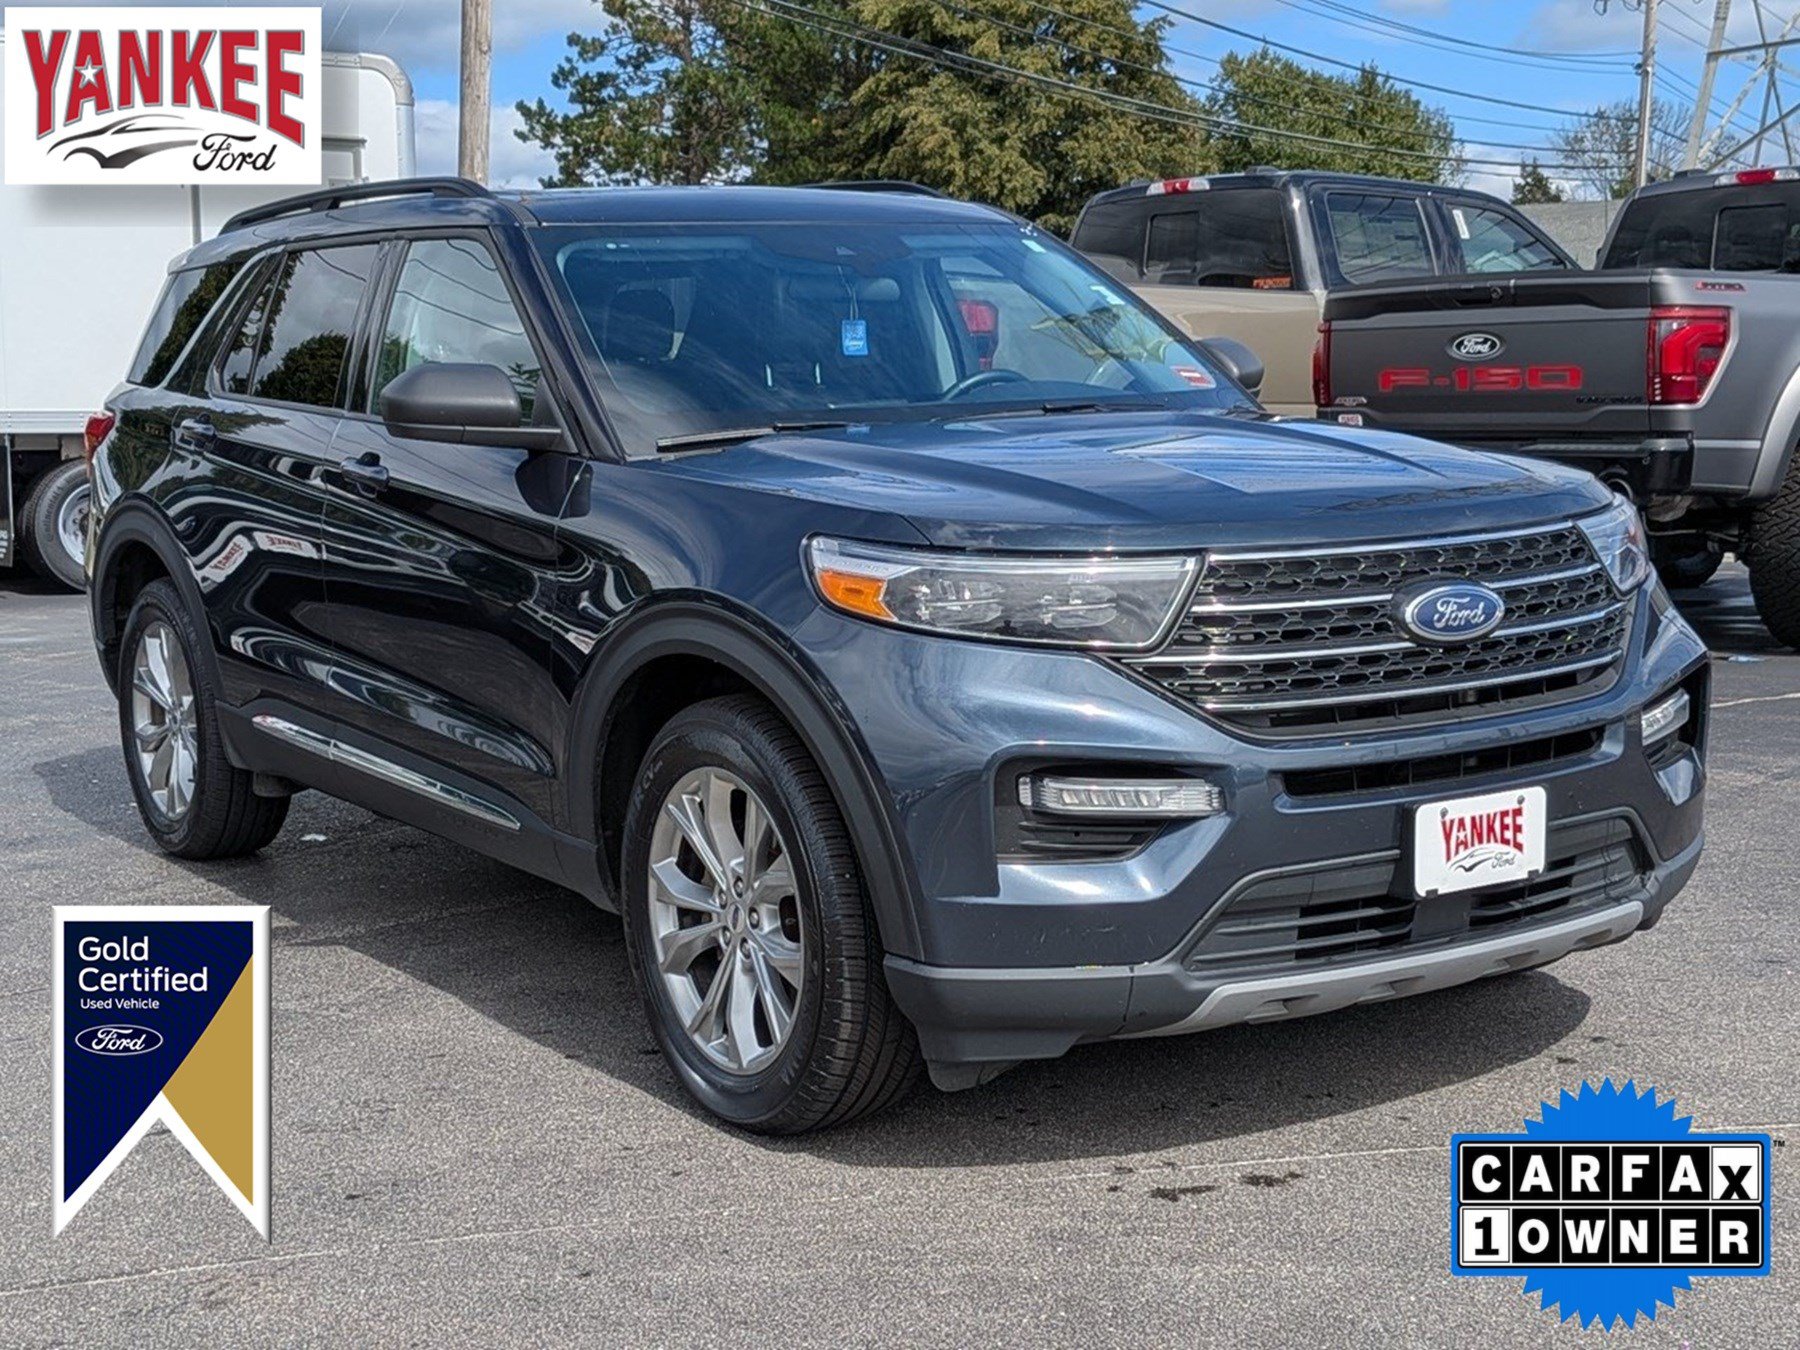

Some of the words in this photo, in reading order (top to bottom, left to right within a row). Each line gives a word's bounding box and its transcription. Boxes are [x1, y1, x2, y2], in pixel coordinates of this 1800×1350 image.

[1459, 336, 1491, 354] Ford
[1378, 365, 1584, 392] F-150
[1433, 596, 1486, 629] Ford
[1441, 806, 1524, 865] YANKEE
[1491, 850, 1517, 869] Ford
